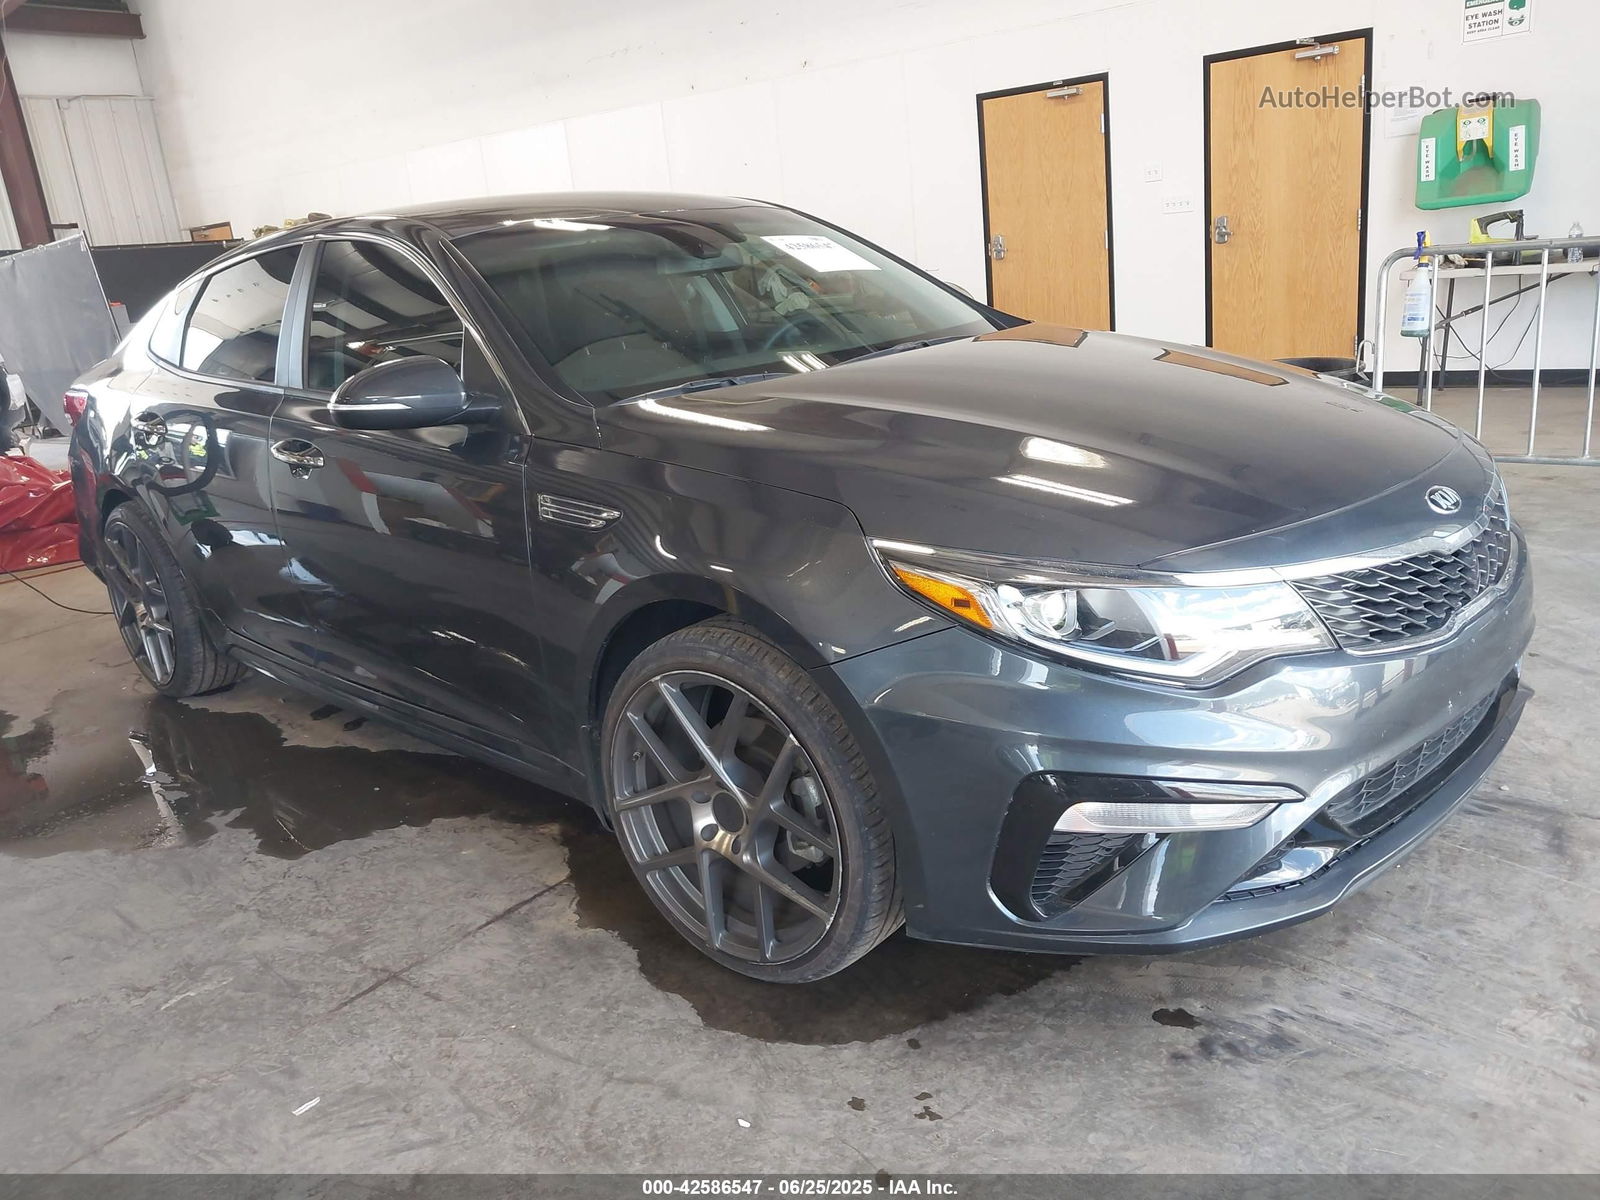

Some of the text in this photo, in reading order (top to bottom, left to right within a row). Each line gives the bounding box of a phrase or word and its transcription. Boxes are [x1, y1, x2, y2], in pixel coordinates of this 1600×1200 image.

[1465, 9, 1503, 22] EYE WASH
[1468, 18, 1500, 30] STATION
